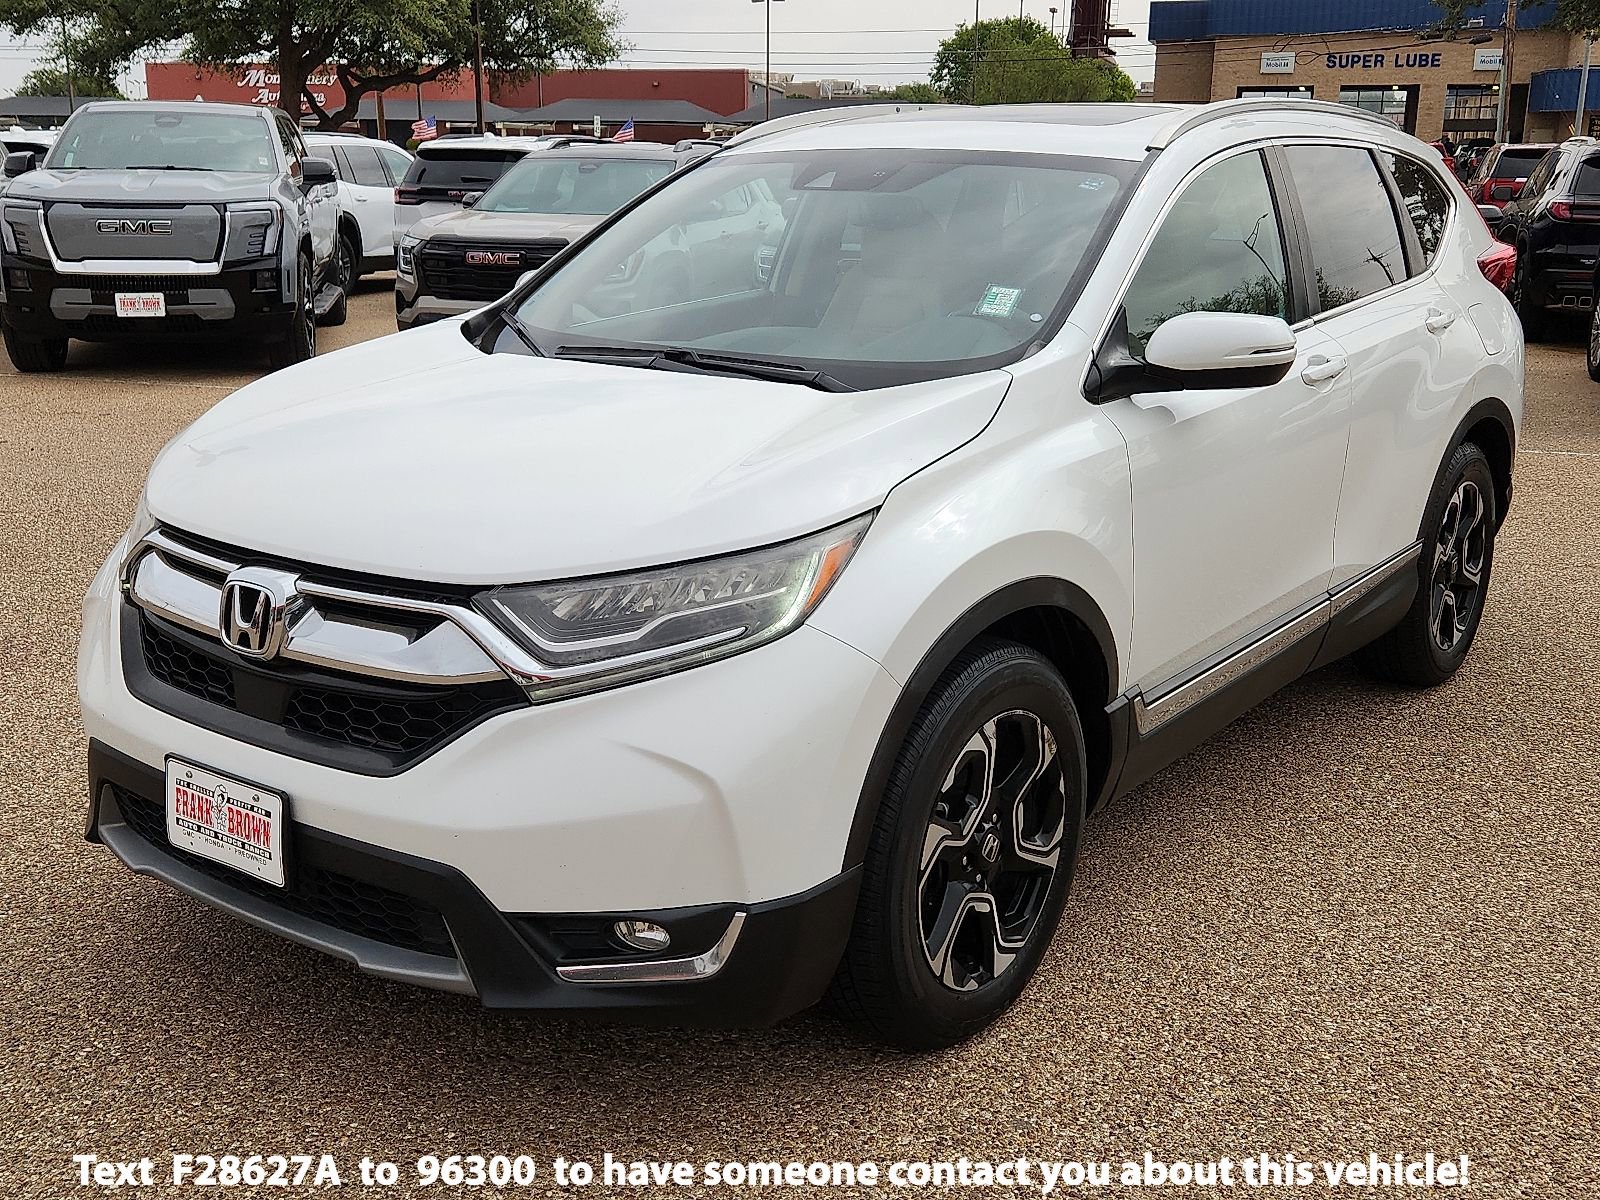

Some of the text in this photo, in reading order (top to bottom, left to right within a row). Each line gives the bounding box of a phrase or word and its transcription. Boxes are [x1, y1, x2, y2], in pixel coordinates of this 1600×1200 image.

[1326, 53, 1442, 68] SUPER LUBE
[96, 219, 172, 235] GMC
[466, 251, 520, 265] GMC
[175, 787, 271, 849] FRANK BROWN
[178, 820, 270, 859] AUTO AND TRUCK RANCH
[182, 828, 195, 839] GMC
[205, 837, 225, 849] HONDA
